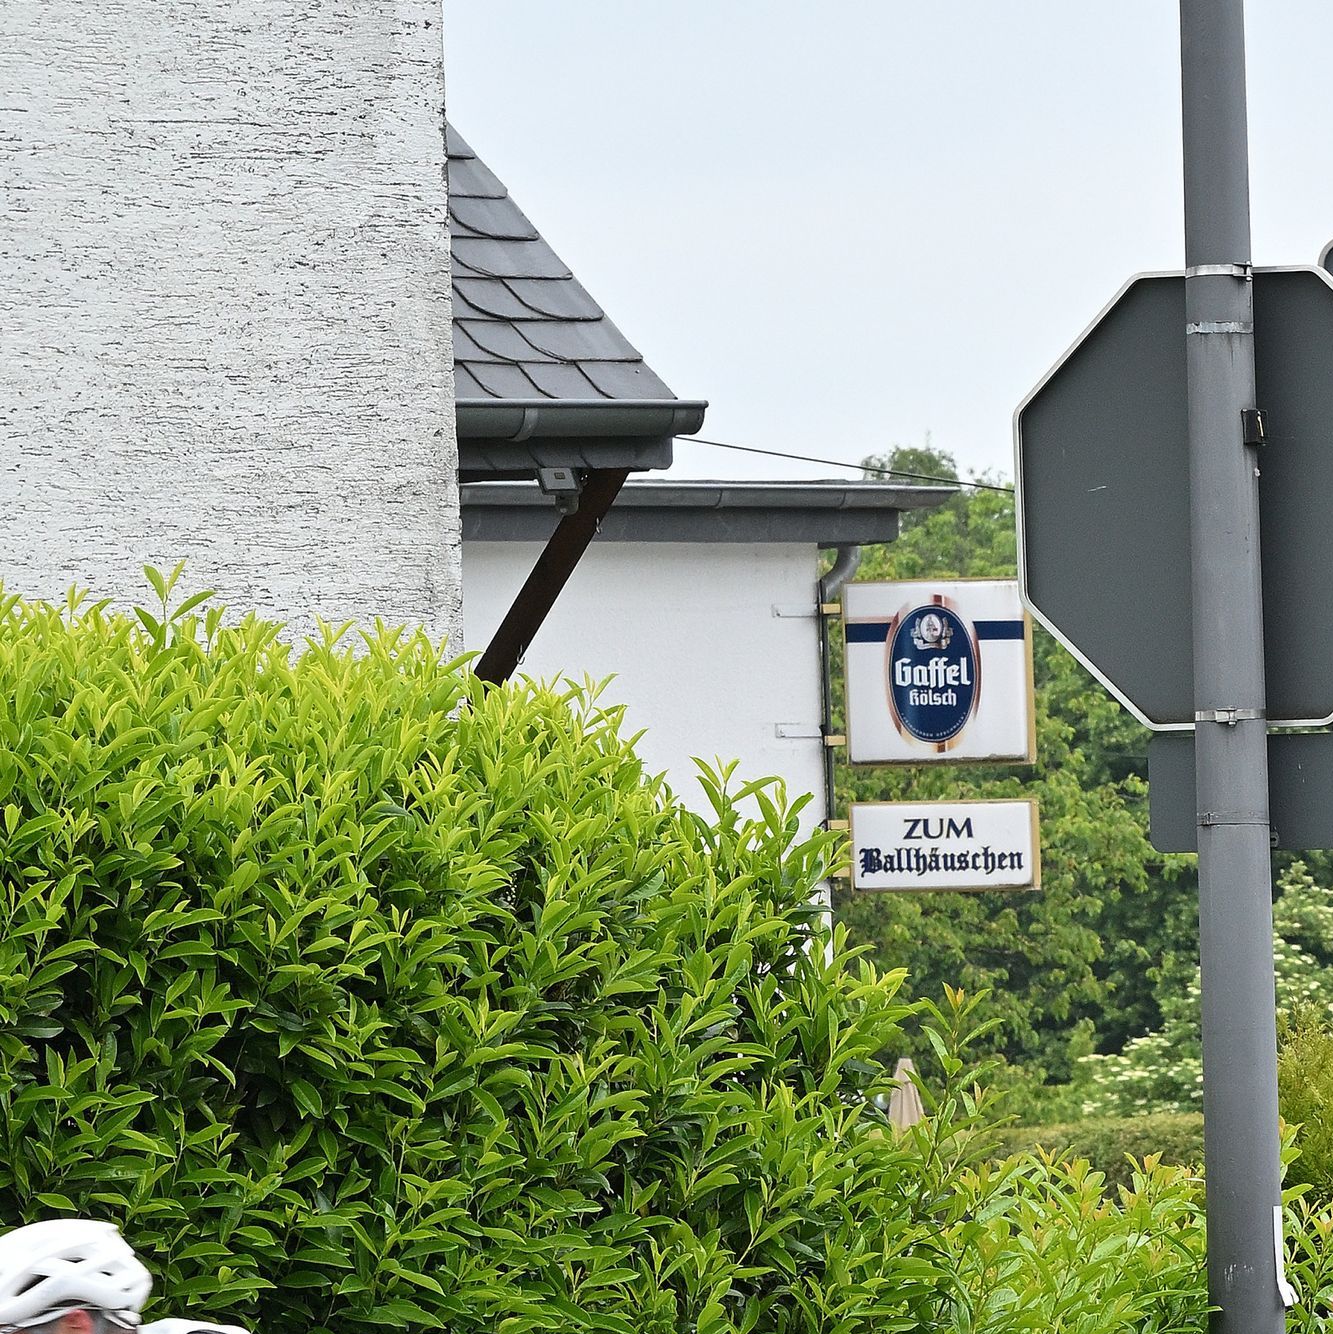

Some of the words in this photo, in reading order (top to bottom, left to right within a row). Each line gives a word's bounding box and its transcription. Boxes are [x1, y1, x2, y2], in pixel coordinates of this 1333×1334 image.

[895, 657, 971, 688] Gaffel
[909, 688, 957, 707] Kölsch
[903, 817, 974, 840] ZUM
[859, 846, 1024, 878] Ballhäuschen
